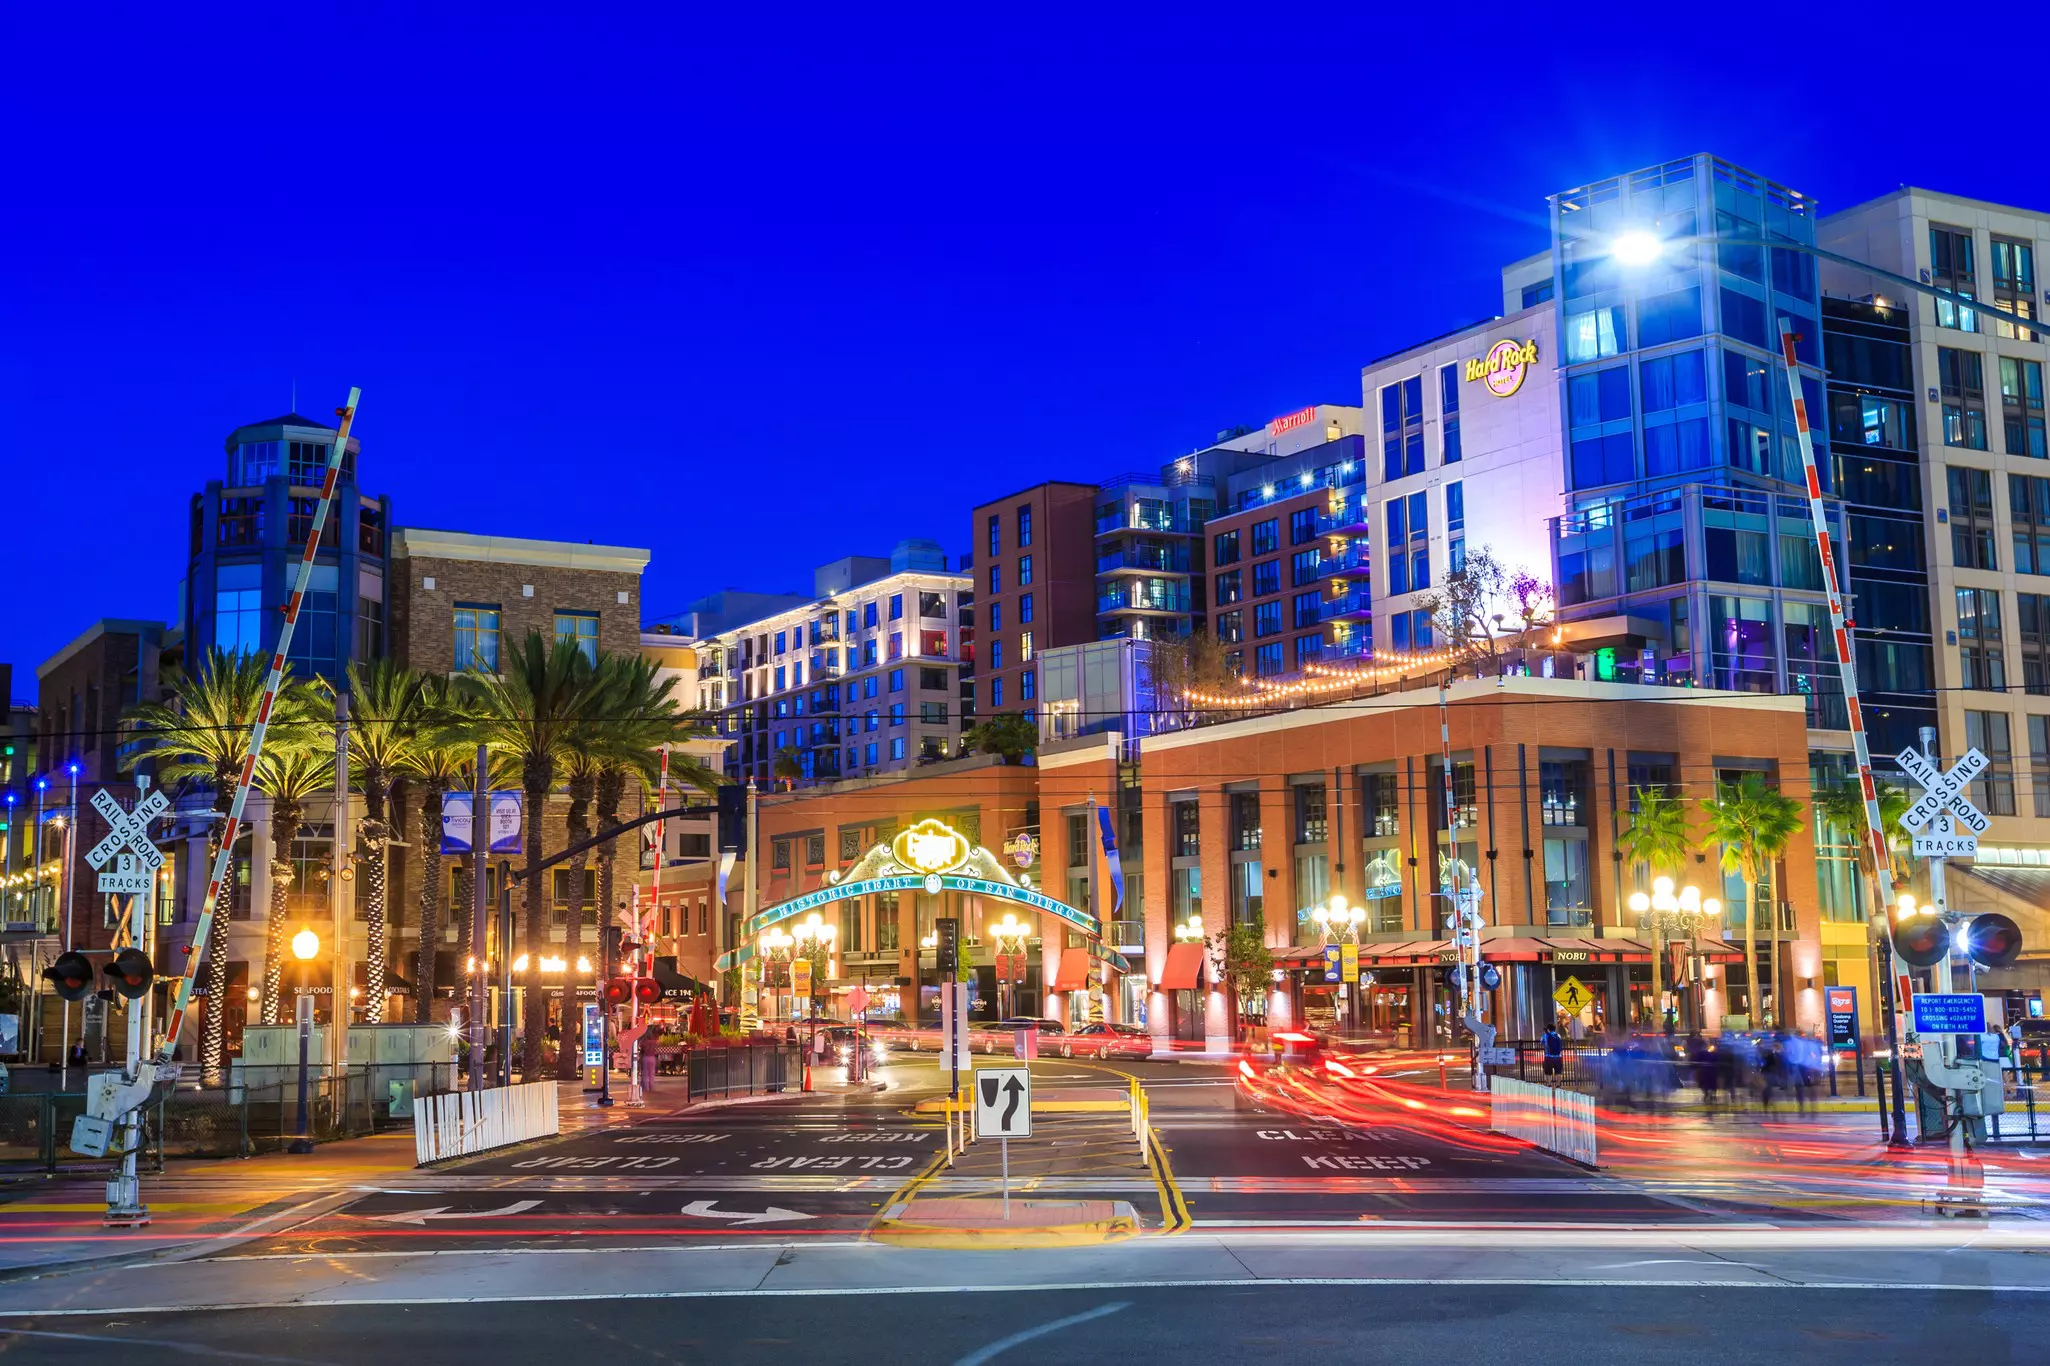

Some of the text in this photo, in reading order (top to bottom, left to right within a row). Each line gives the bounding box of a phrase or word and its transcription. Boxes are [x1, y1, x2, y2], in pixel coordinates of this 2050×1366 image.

[1465, 339, 1538, 382] Hard Rock
[1272, 406, 1315, 436] Marriott
[1900, 751, 1986, 831] RAIL ROAD
[1907, 755, 1981, 827] CROSSING
[92, 797, 162, 863] CROSSING
[94, 792, 161, 868] RAIL ROAD
[1940, 818, 1949, 833] 3
[1916, 840, 1975, 852] TRACKS
[122, 857, 131, 871] 3
[101, 877, 150, 889] TRACKS
[779, 878, 1075, 919] HISTORIC HEART OF SAN DIEGO
[1557, 952, 1587, 961] NOBU
[818, 1133, 931, 1143] KEEP
[1255, 1129, 1399, 1141] CLEAR
[510, 1156, 681, 1169] CLEAR
[750, 1156, 914, 1169] CLEAR
[1300, 1155, 1432, 1170] KEEP
